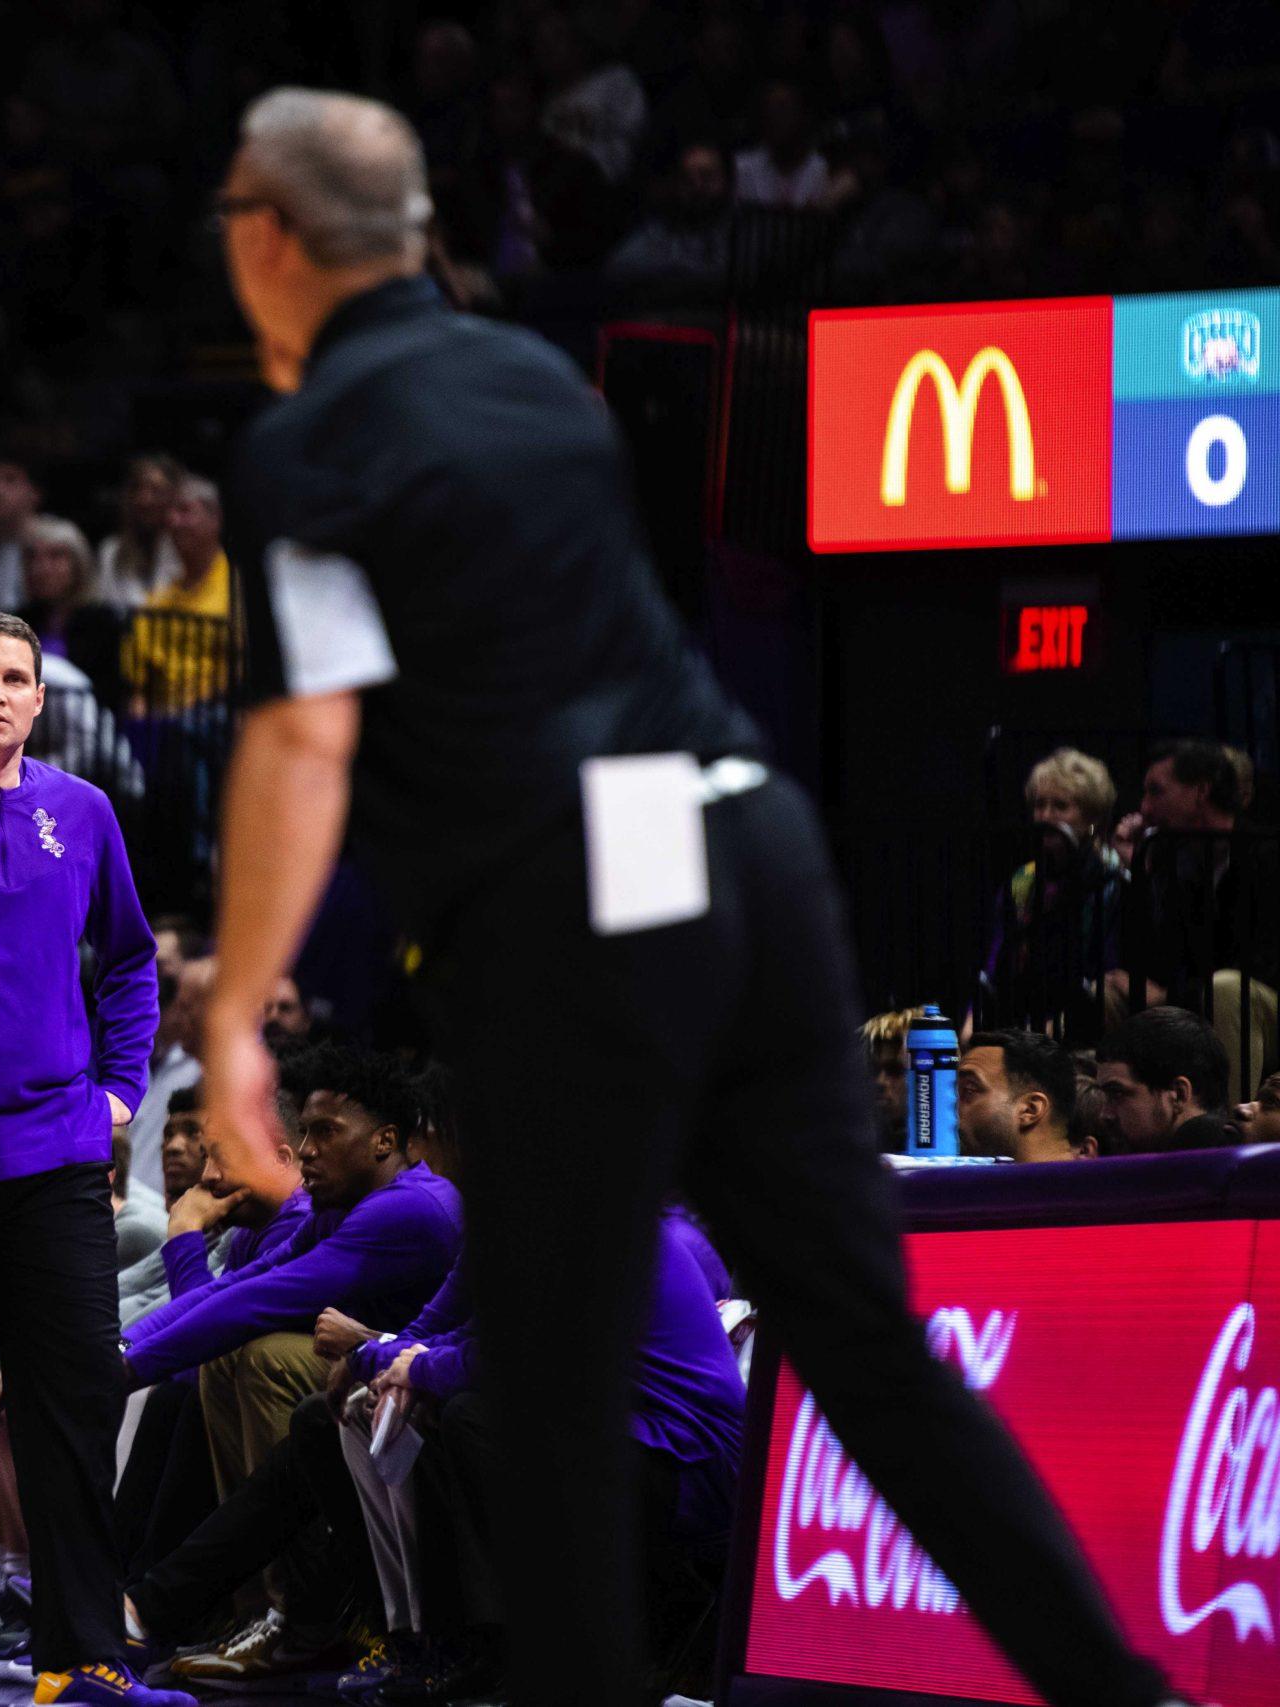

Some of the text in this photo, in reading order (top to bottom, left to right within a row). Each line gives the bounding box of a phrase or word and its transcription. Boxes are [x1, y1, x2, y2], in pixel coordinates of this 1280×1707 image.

[1186, 414, 1248, 506] 0
[1017, 604, 1088, 671] EXIT
[918, 1074, 930, 1144] POWERADE
